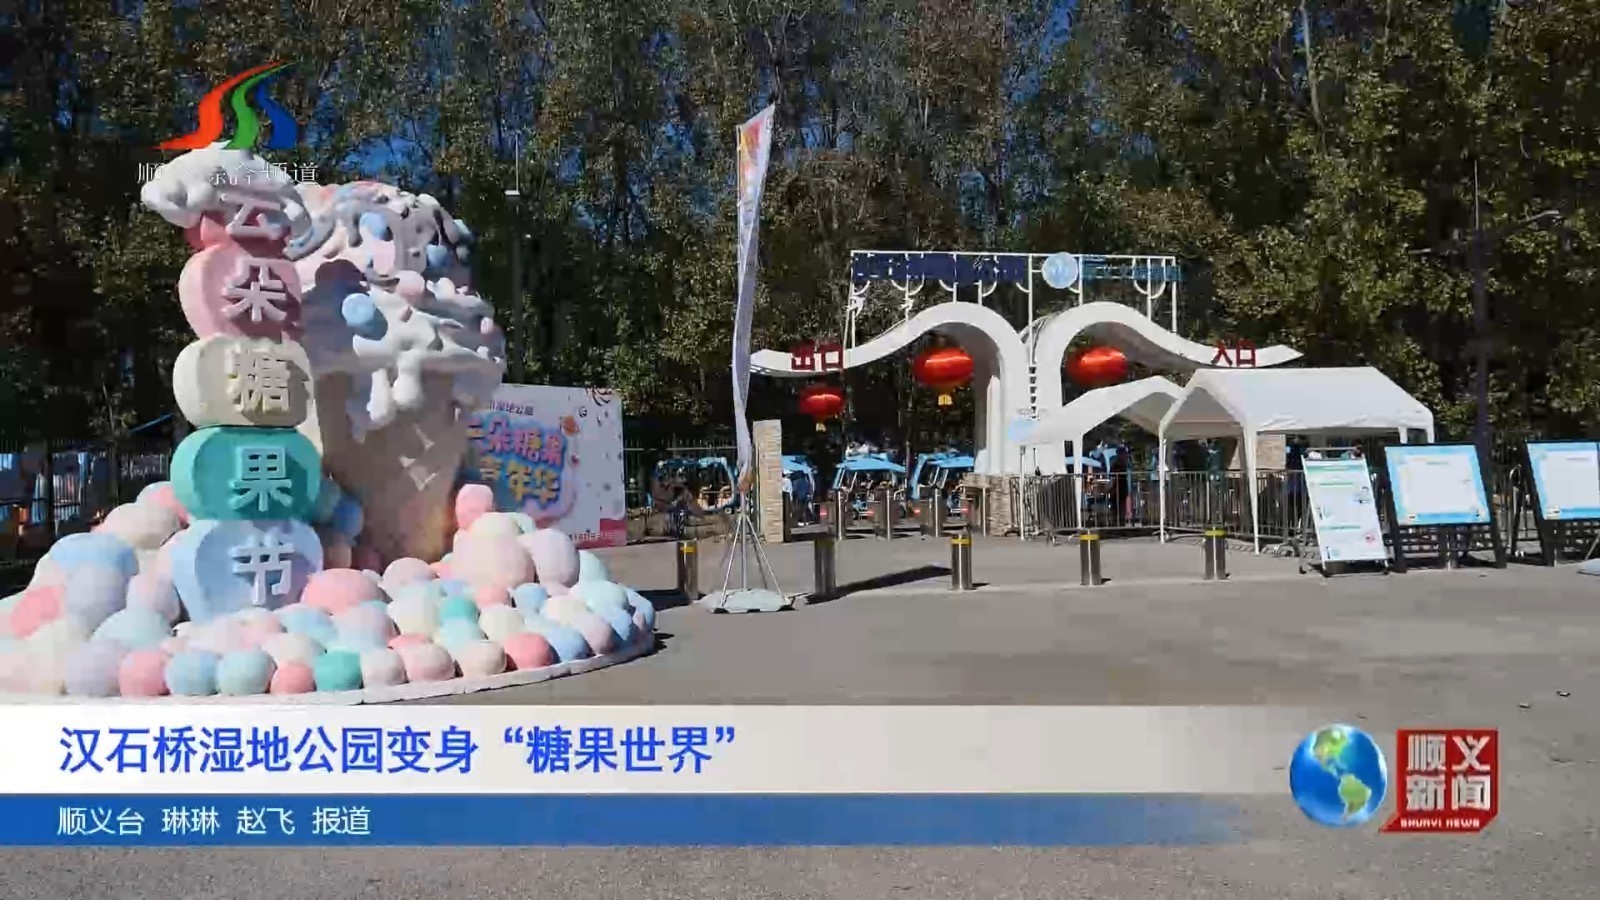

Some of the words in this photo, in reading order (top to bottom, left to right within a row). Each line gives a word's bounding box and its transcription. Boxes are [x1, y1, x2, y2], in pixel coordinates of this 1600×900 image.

[789, 339, 844, 371] 出口
[1211, 339, 1256, 367] 入口
[222, 196, 297, 606] 云朵糖果节
